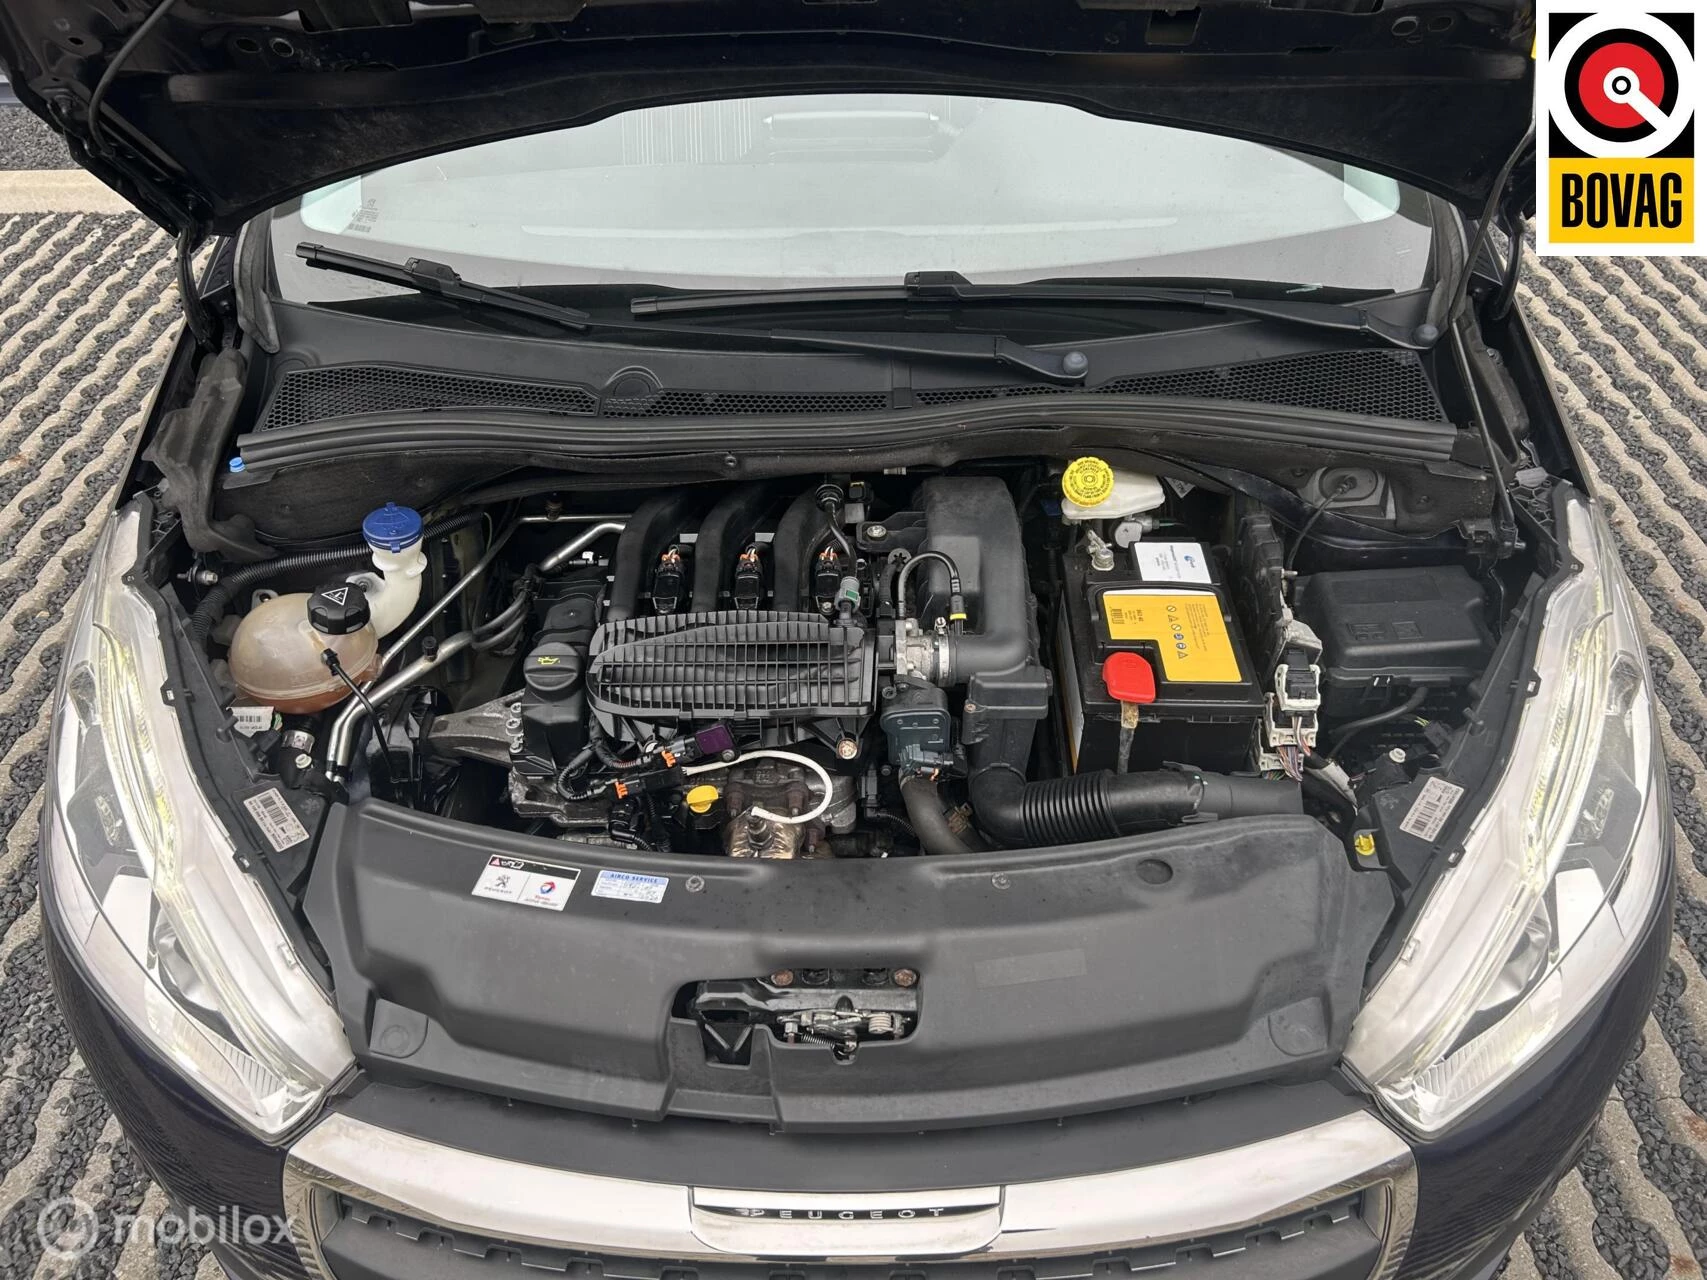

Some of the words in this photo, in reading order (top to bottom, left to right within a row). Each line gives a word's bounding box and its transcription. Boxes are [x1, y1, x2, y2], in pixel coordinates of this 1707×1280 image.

[610, 873, 630, 881] AIRCO
[632, 876, 658, 884] SERVICE
[749, 1207, 944, 1220] PEUGEOT
